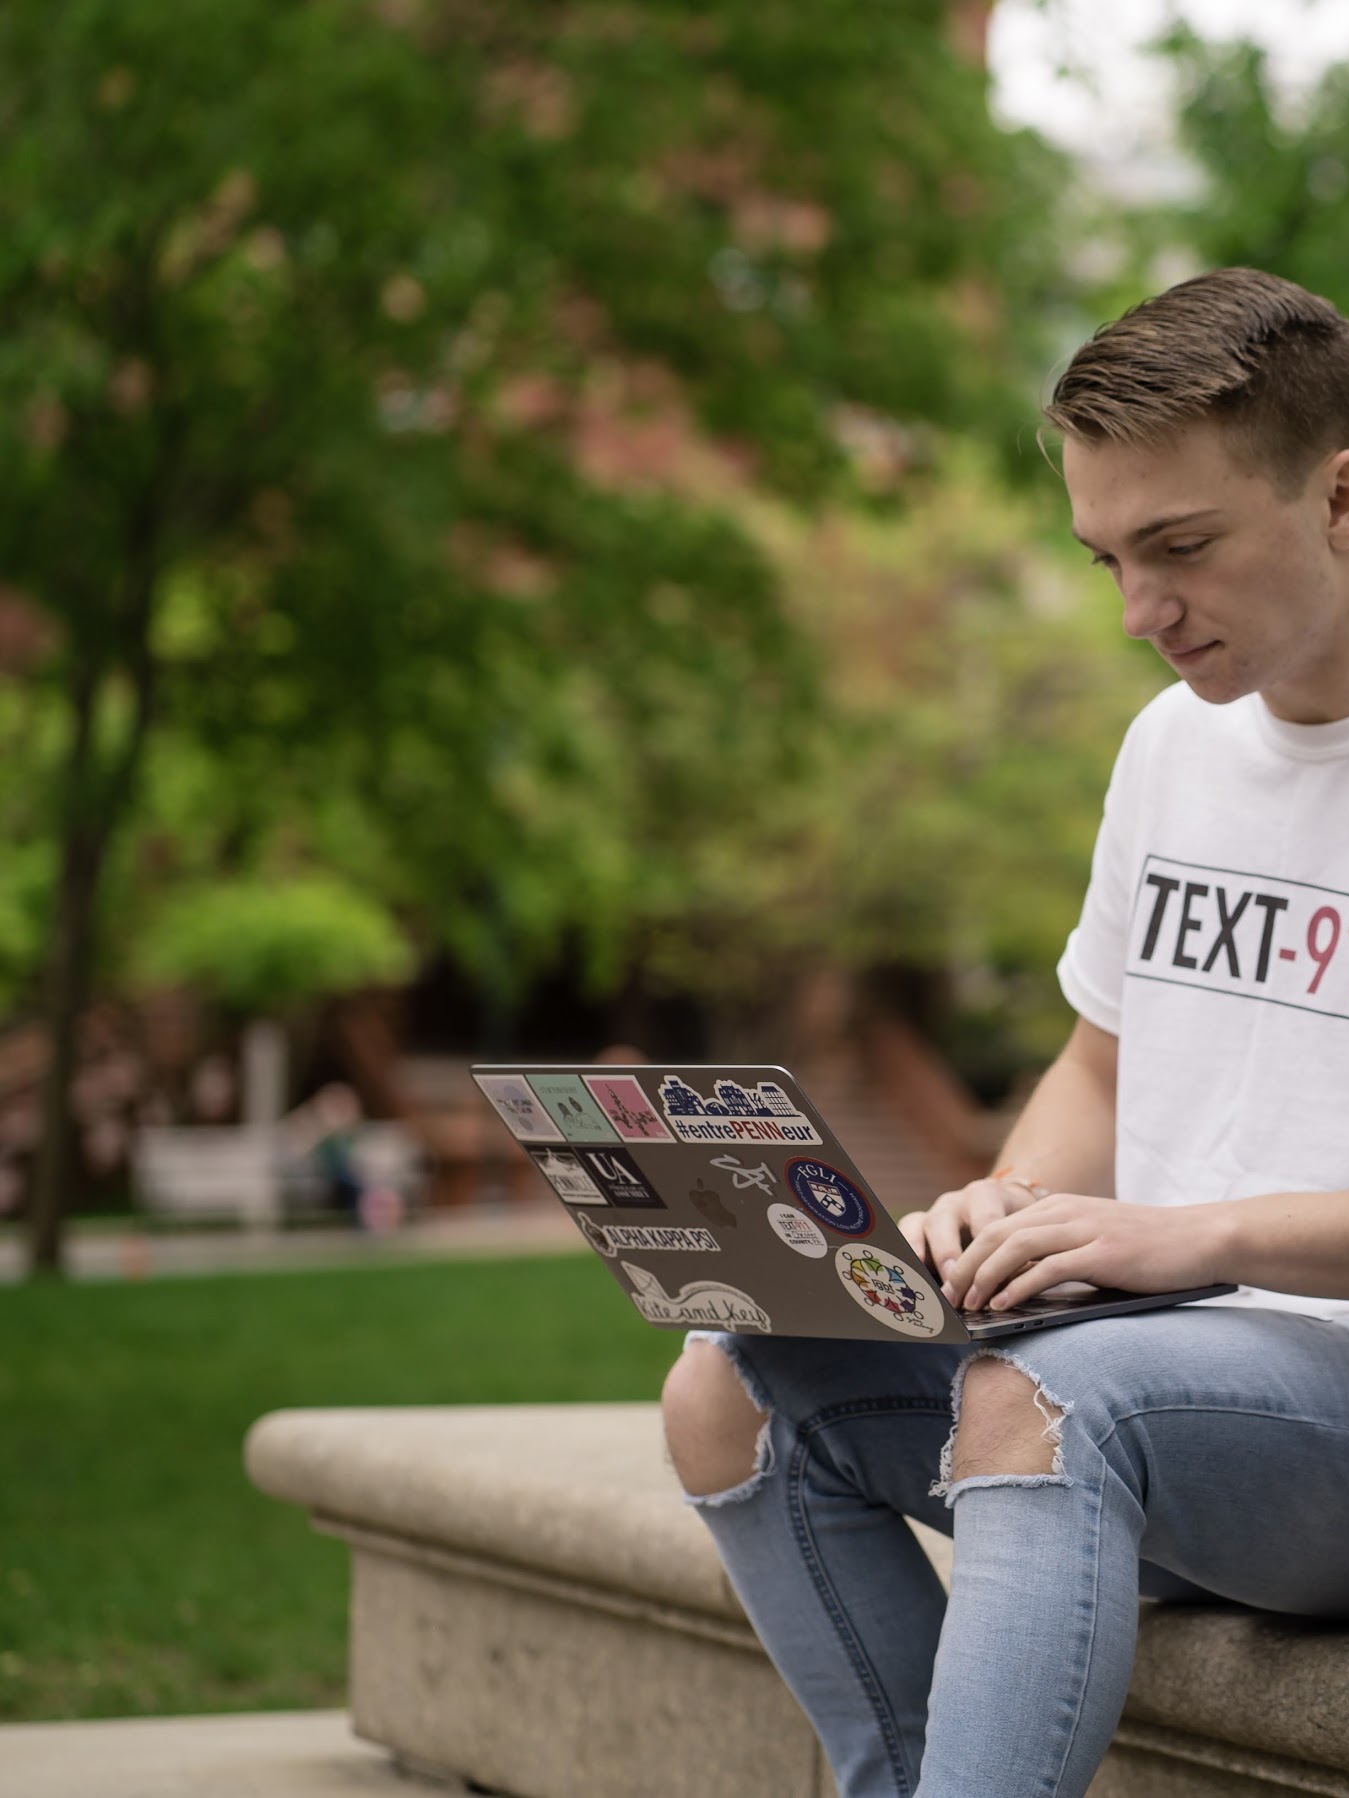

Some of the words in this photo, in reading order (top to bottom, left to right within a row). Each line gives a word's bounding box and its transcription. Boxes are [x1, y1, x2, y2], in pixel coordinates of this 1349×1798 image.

[675, 1119, 815, 1141] #entrePENNeur
[586, 1152, 642, 1185] UA
[797, 1164, 836, 1184] FGLI
[605, 1228, 649, 1246] ALPHA
[646, 1229, 694, 1248] KAPPA
[695, 1231, 717, 1250] PSI
